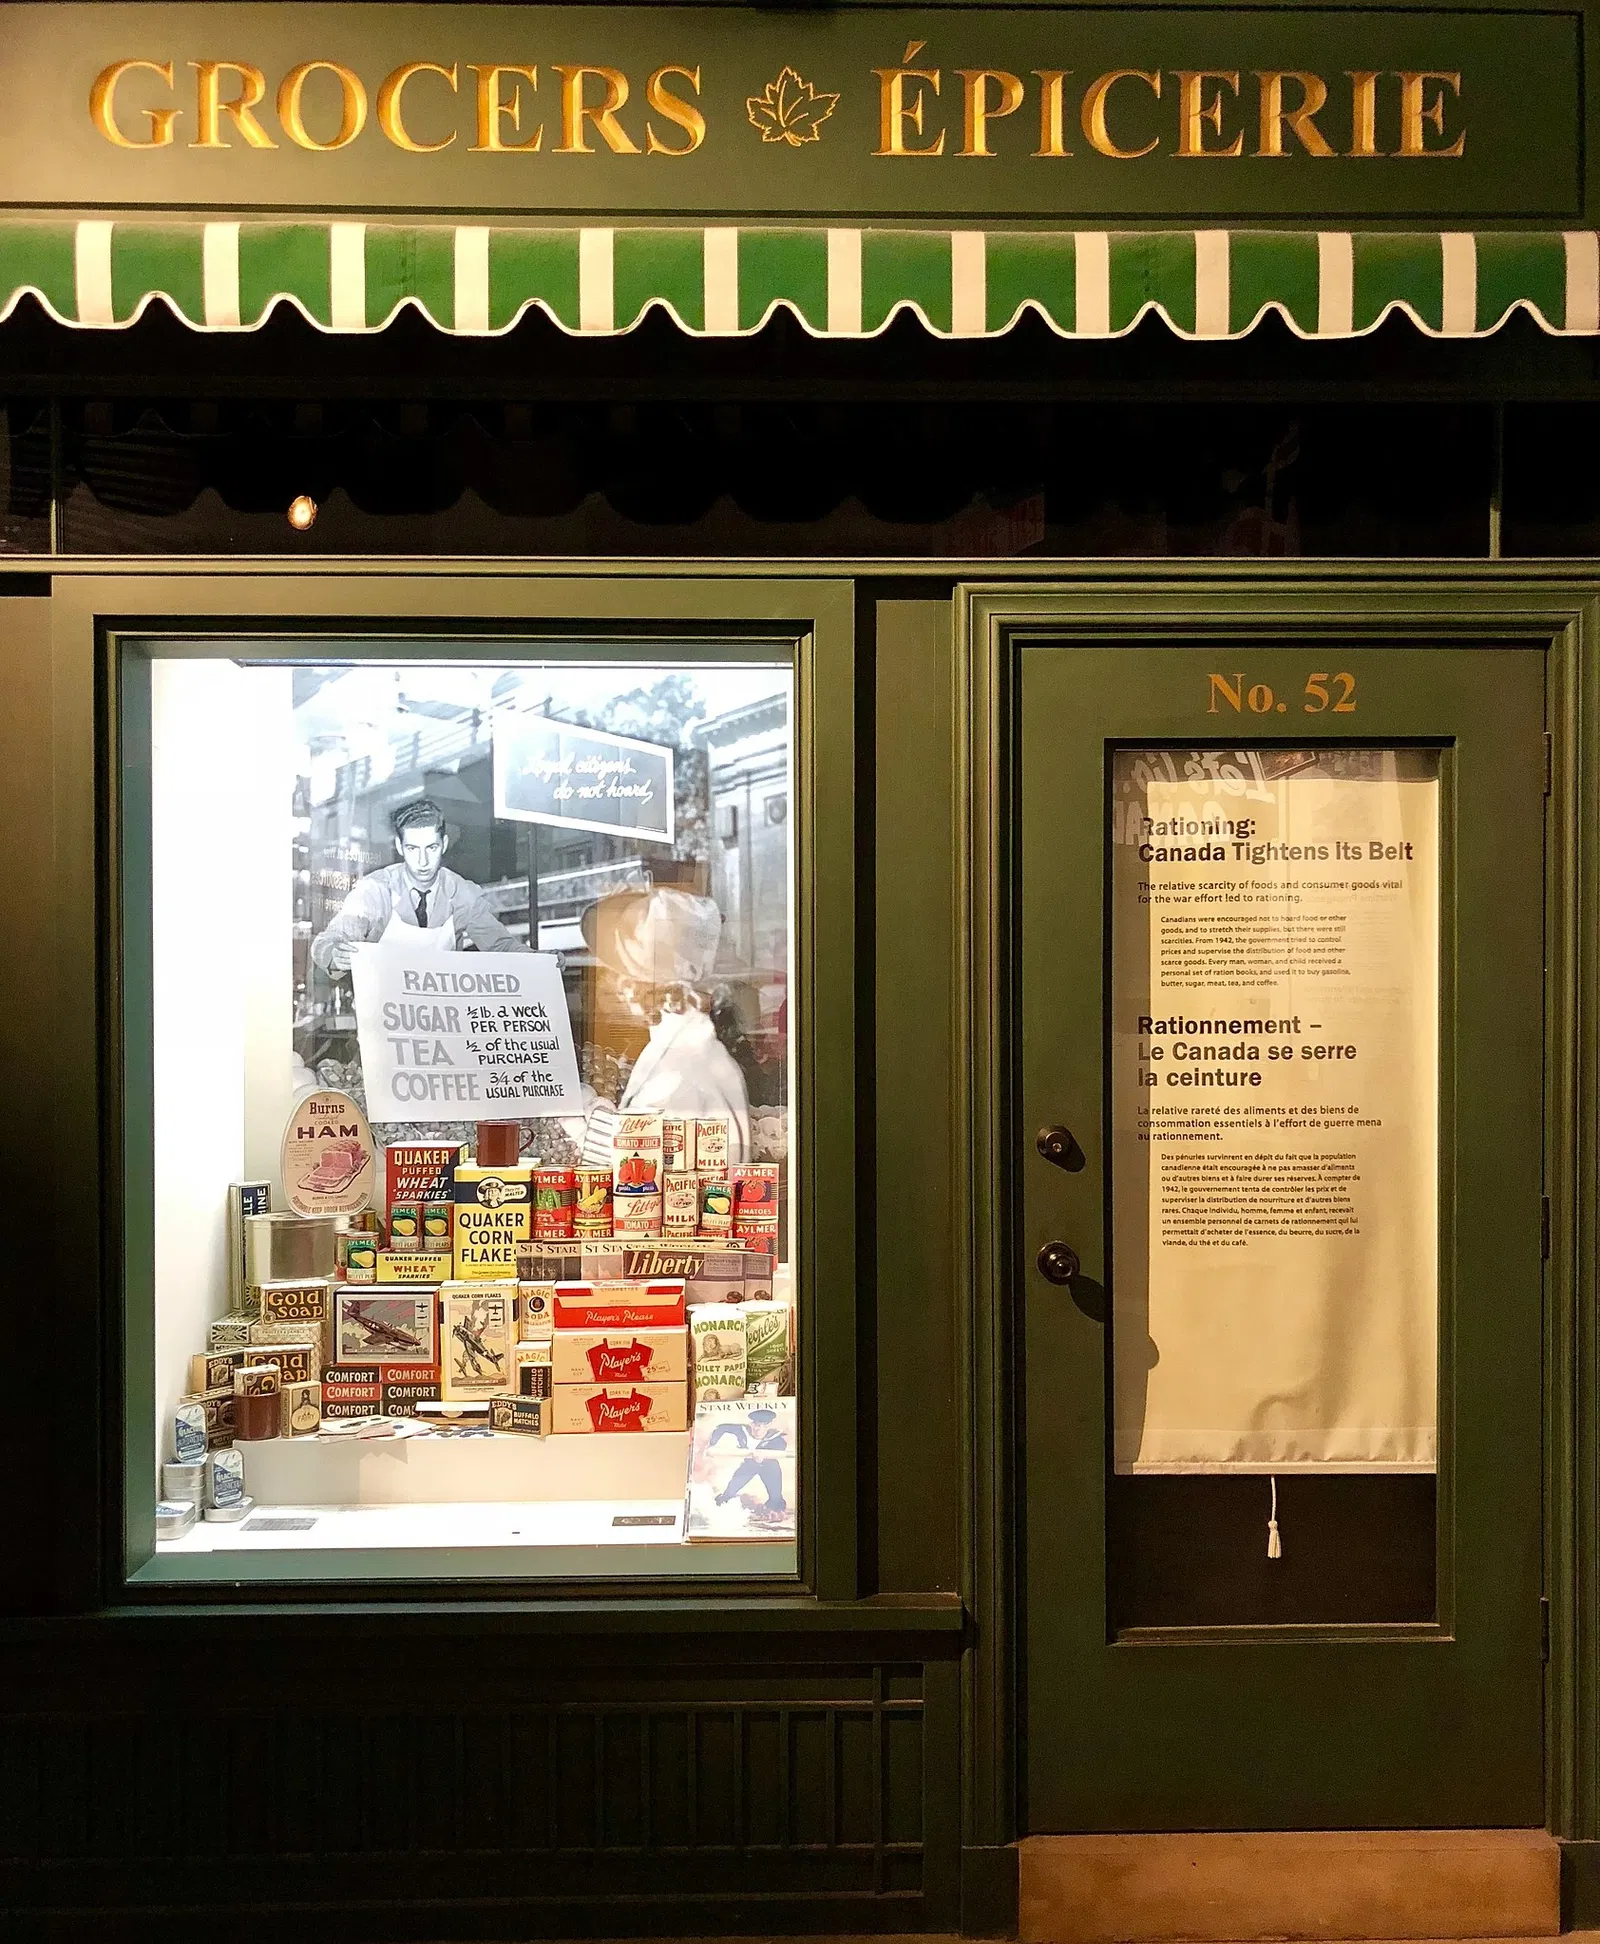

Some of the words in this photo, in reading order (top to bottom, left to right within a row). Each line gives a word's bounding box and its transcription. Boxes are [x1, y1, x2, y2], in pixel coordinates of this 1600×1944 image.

[89, 59, 706, 156] GROCERS
[870, 41, 1466, 158] ÉPICERIE
[1207, 674, 1287, 713] No.
[1304, 672, 1357, 713] 52
[553, 780, 574, 800] do
[577, 781, 606, 798] not
[1139, 817, 1256, 838] Rationing:
[1137, 843, 1226, 862] Canada
[1231, 842, 1328, 864] Tightens
[1336, 842, 1362, 860] its
[1369, 842, 1413, 860] Belt
[1138, 881, 1156, 890] The
[1158, 881, 1196, 890] relative
[1198, 881, 1237, 891] scarcity
[1238, 880, 1249, 889] of
[1250, 880, 1278, 889] foods
[1280, 881, 1299, 889] and
[1351, 880, 1380, 891] goods
[1382, 880, 1403, 889] vital
[1138, 894, 1153, 903] for
[1154, 895, 1171, 903] the
[1194, 893, 1224, 903] effort
[1224, 893, 1241, 902] led
[1242, 894, 1254, 902] to
[1255, 895, 1303, 903] rationing.
[403, 970, 521, 993] RATIONED
[383, 1002, 462, 1033] SUGAR
[498, 1005, 509, 1018] a
[509, 1002, 548, 1018] week
[470, 1021, 498, 1034] PER
[503, 1020, 551, 1033] PERSON
[1138, 1016, 1300, 1034] Rationnement
[387, 1037, 455, 1066] TEA
[485, 1038, 502, 1051] of
[504, 1038, 527, 1051] the
[530, 1036, 560, 1051] usual
[1138, 1043, 1164, 1060] Le
[1172, 1042, 1260, 1060] Canada
[1268, 1046, 1293, 1060] se
[1301, 1046, 1356, 1060] serre
[478, 1053, 549, 1066] PURCHASE
[1138, 1068, 1158, 1086] la
[1166, 1068, 1262, 1086] ceinture
[391, 1072, 481, 1101] COFFEE
[513, 1070, 529, 1084] of
[531, 1070, 554, 1083] the
[485, 1085, 521, 1099] USUAL
[522, 1083, 565, 1098] PURCHASE
[309, 1102, 345, 1115] Burns
[1137, 1106, 1150, 1115] La
[1151, 1106, 1189, 1115] relative
[1190, 1107, 1221, 1115] rareté
[1223, 1106, 1241, 1115] des
[1243, 1106, 1287, 1115] aliments
[1288, 1107, 1299, 1115] et
[1300, 1106, 1318, 1115] des
[1319, 1105, 1346, 1114] biens
[1347, 1105, 1359, 1114] de
[697, 1123, 727, 1136] PACIFIC
[1137, 1120, 1211, 1128] consommation
[1213, 1119, 1263, 1128] essentiels
[1264, 1119, 1271, 1128] à
[1308, 1118, 1321, 1127] de
[1323, 1120, 1354, 1129] guerre
[1356, 1119, 1382, 1127] mena
[297, 1124, 358, 1140] HAM
[1138, 1133, 1150, 1141] au
[640, 1138, 659, 1148] JUICE
[394, 1150, 450, 1167] QUAKER
[699, 1158, 726, 1166] MILK
[1254, 1153, 1274, 1161] dépit
[1285, 1153, 1298, 1161] fait
[1320, 1153, 1357, 1161] population
[402, 1167, 442, 1175] PUFFED
[735, 1168, 775, 1177] AYLMER
[397, 1176, 449, 1189] WHEAT
[533, 1175, 566, 1184] YLMER
[574, 1174, 612, 1183] AYLMER
[666, 1178, 696, 1193] PACIFIC
[459, 1213, 525, 1229] QUAKER
[667, 1215, 695, 1223] MILK
[737, 1225, 776, 1234] AYLMER
[469, 1230, 513, 1245] CORN
[547, 1245, 577, 1254] STAR
[393, 1265, 436, 1273] WHEAT
[627, 1250, 705, 1280] Liberty
[269, 1291, 320, 1307] Gold
[522, 1289, 550, 1300] MAGIC
[276, 1304, 323, 1319] soap
[524, 1312, 550, 1321] SODA
[585, 1310, 620, 1324] Player's
[622, 1310, 654, 1323] Please
[693, 1320, 744, 1334] MONARCH
[746, 1315, 780, 1344] eople's
[517, 1352, 545, 1363] MAGIC
[599, 1352, 641, 1375] Player's
[326, 1371, 374, 1383] COMFORT
[387, 1368, 435, 1380] COMFORT
[326, 1386, 375, 1398] COMFORT
[387, 1386, 436, 1397] COMFORT
[326, 1404, 375, 1416] COMFORT
[491, 1401, 517, 1410] EDDY'S
[700, 1403, 731, 1411] STAR
[736, 1402, 788, 1410] WEEKLY
[514, 1412, 539, 1420] BUFFALO
[598, 1402, 640, 1425] Player's
[514, 1418, 539, 1426] MATCHES
